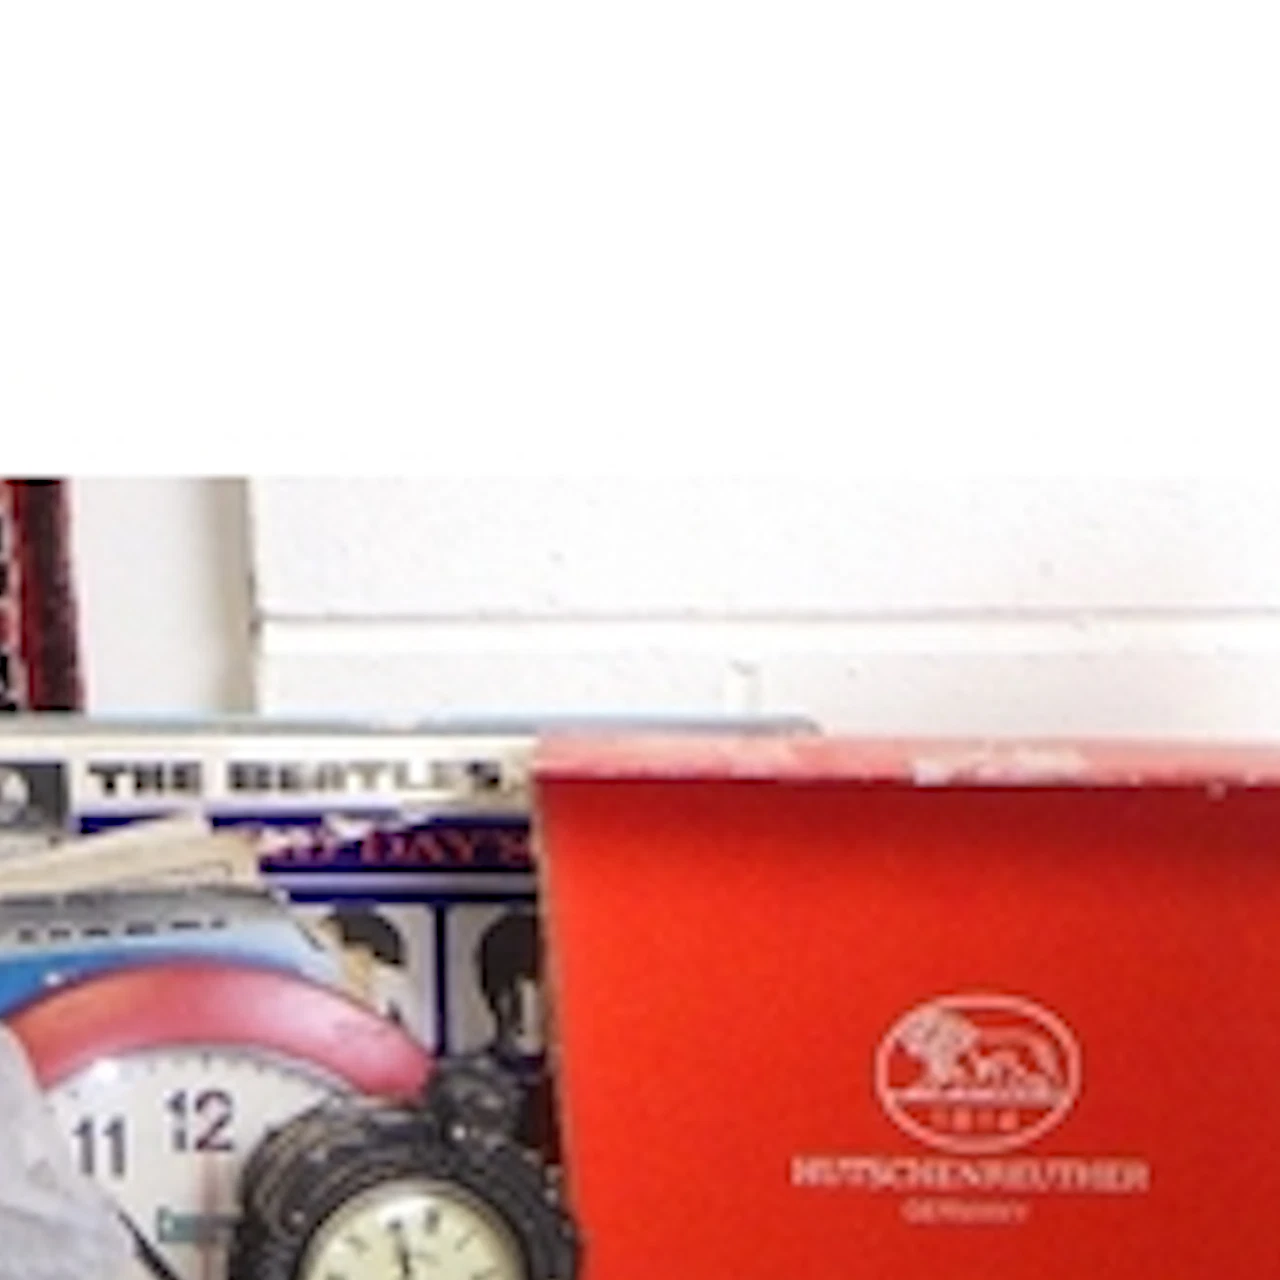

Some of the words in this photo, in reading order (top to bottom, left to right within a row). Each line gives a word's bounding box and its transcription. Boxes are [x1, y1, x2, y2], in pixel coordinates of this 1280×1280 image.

[85, 762, 205, 797] THE
[226, 760, 502, 796] BEATLES
[166, 1088, 236, 1154] 12
[73, 1115, 126, 1180] 11
[789, 1156, 1152, 1192] HUTSCHENREUTHER
